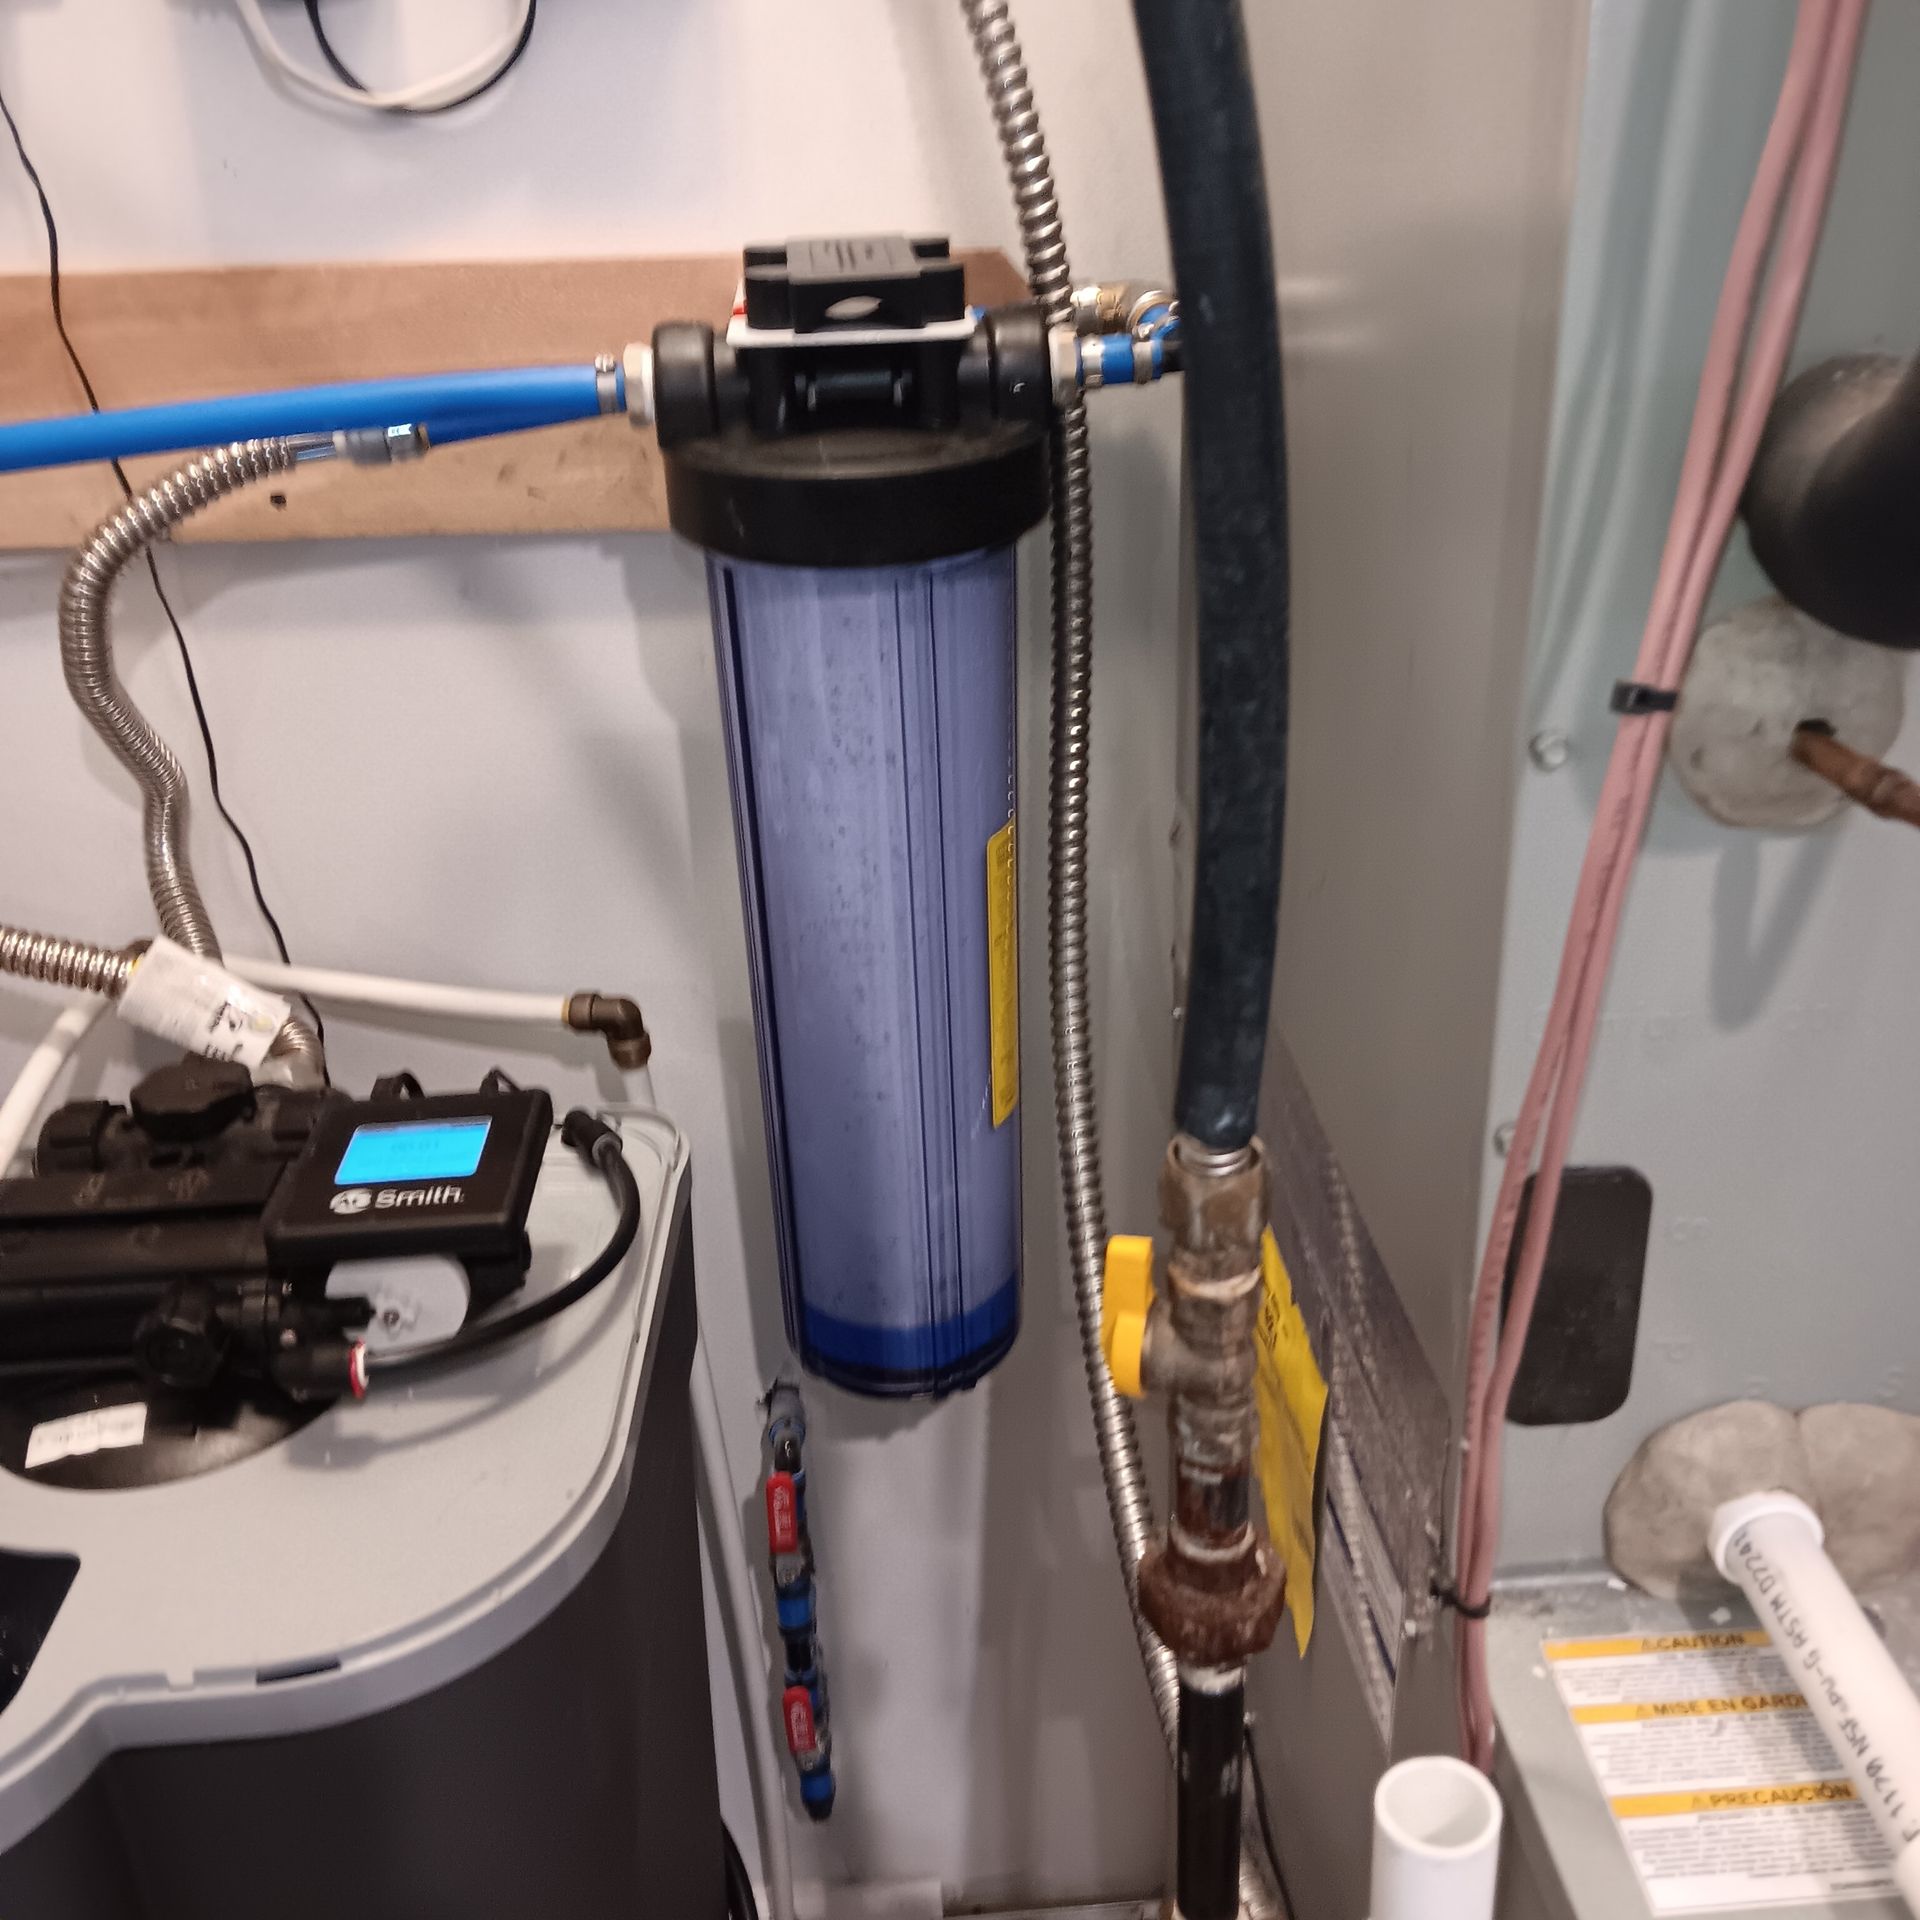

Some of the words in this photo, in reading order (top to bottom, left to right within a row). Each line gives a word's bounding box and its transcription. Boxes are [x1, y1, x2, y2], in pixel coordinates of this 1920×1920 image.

[375, 1184, 463, 1210] Smith
[1769, 1598, 1808, 1651] ASTM
[1656, 1632, 1746, 1651] CAUTION
[1652, 1699, 1700, 1717] MISE
[1708, 1697, 1737, 1713] EN
